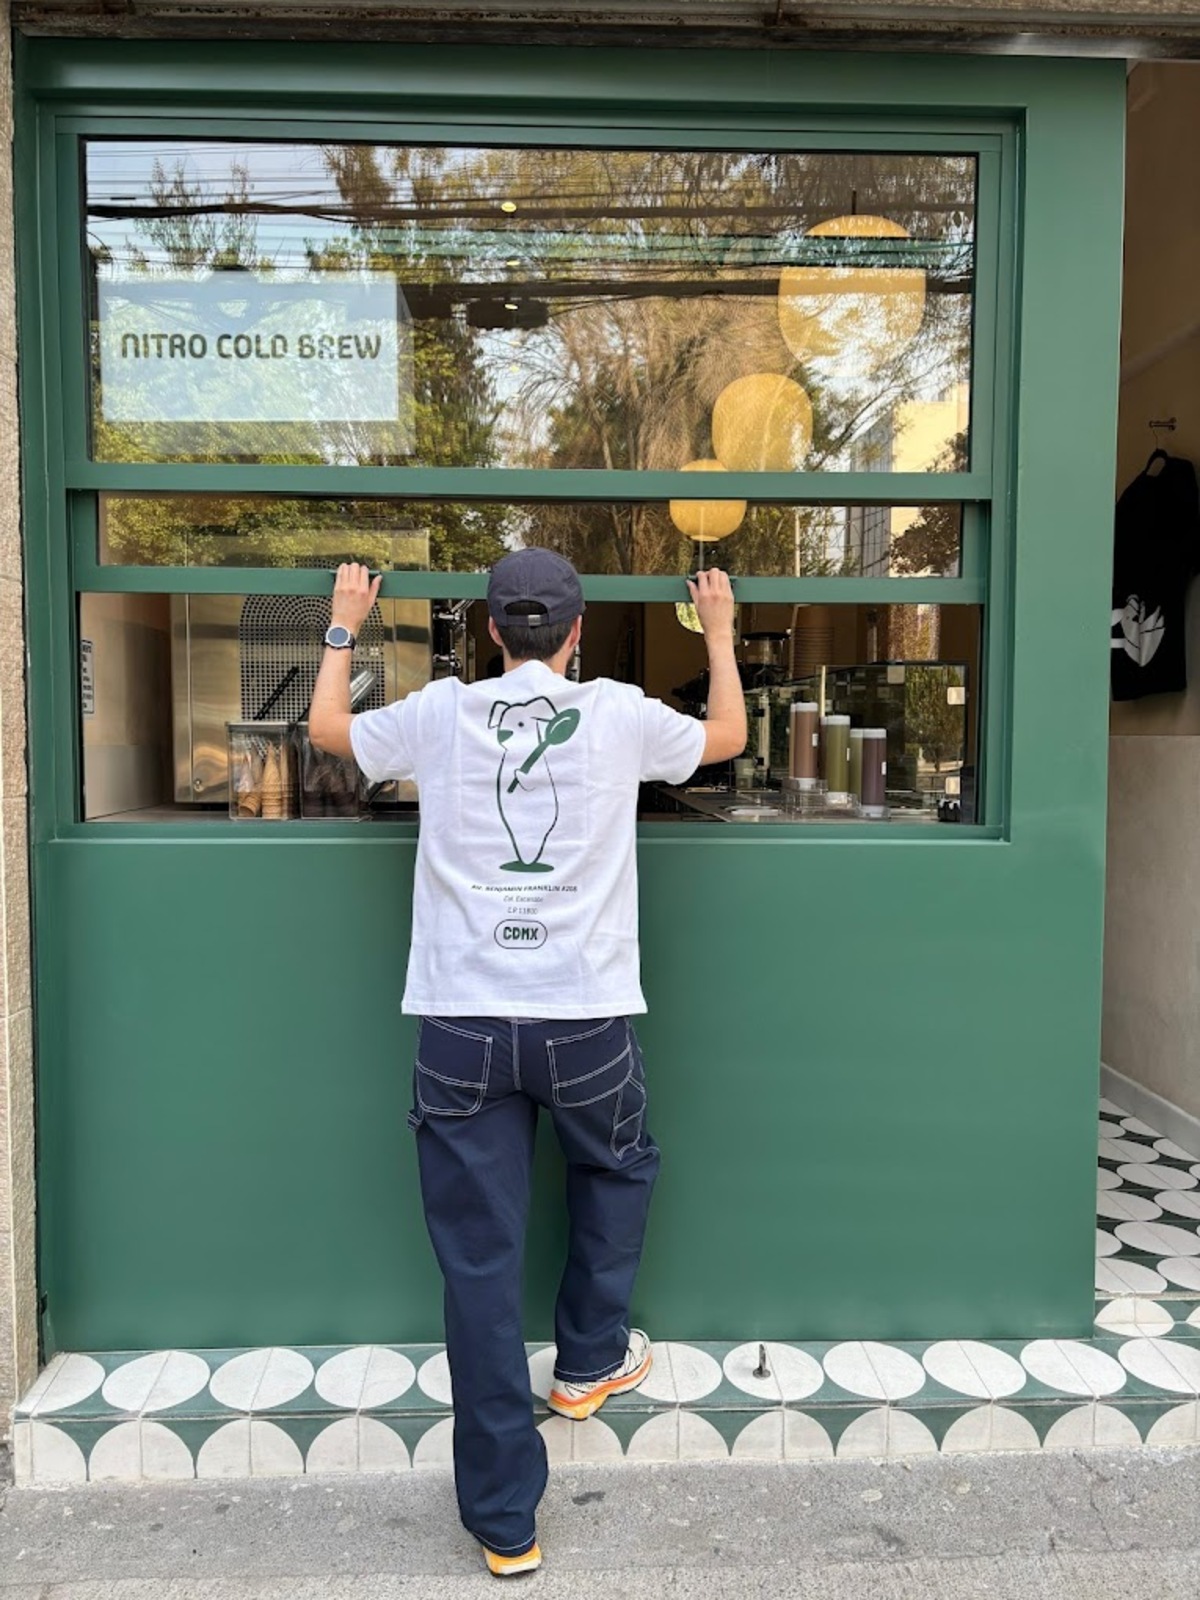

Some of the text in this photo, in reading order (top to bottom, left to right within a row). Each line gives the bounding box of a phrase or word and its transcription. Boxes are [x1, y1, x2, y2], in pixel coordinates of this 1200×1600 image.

[121, 333, 382, 360] NITRO COLD BREW
[503, 926, 539, 941] CDMX
